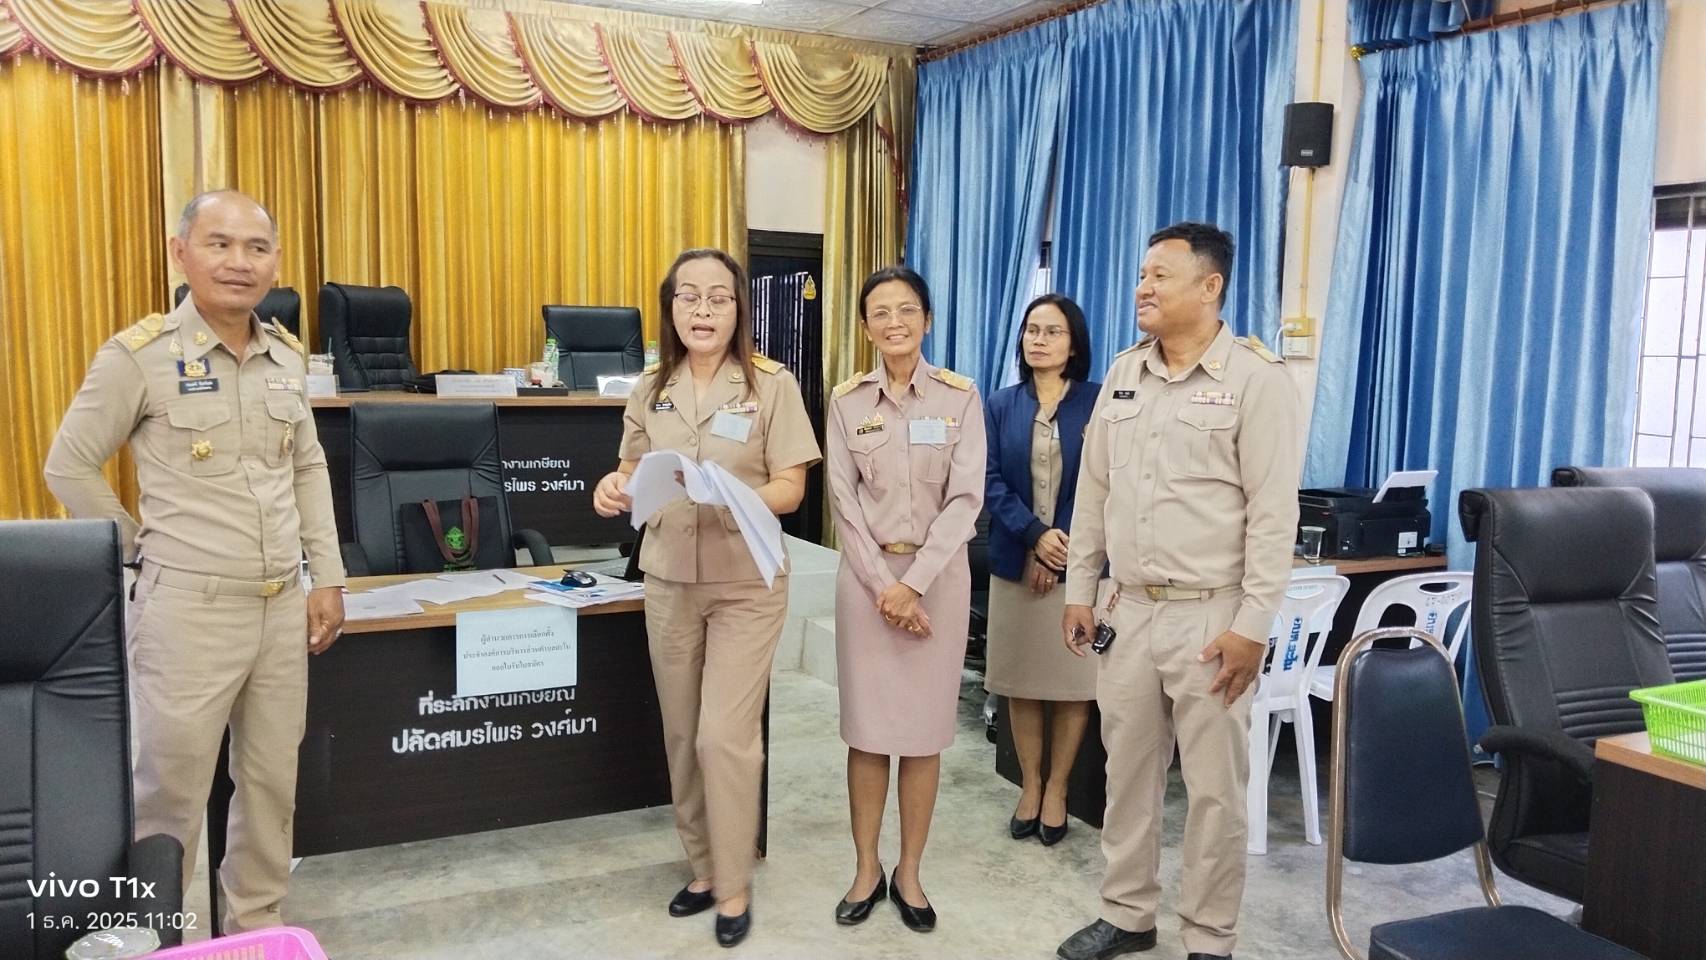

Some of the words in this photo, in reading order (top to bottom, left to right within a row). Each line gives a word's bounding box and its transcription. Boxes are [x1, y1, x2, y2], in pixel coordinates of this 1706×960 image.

[541, 473, 584, 491] วงศ์มา
[419, 688, 575, 715] ที่ระลกงานเกษยณ
[392, 721, 522, 753] ปลัดสมรไพร
[531, 708, 597, 738] วงศ์มา
